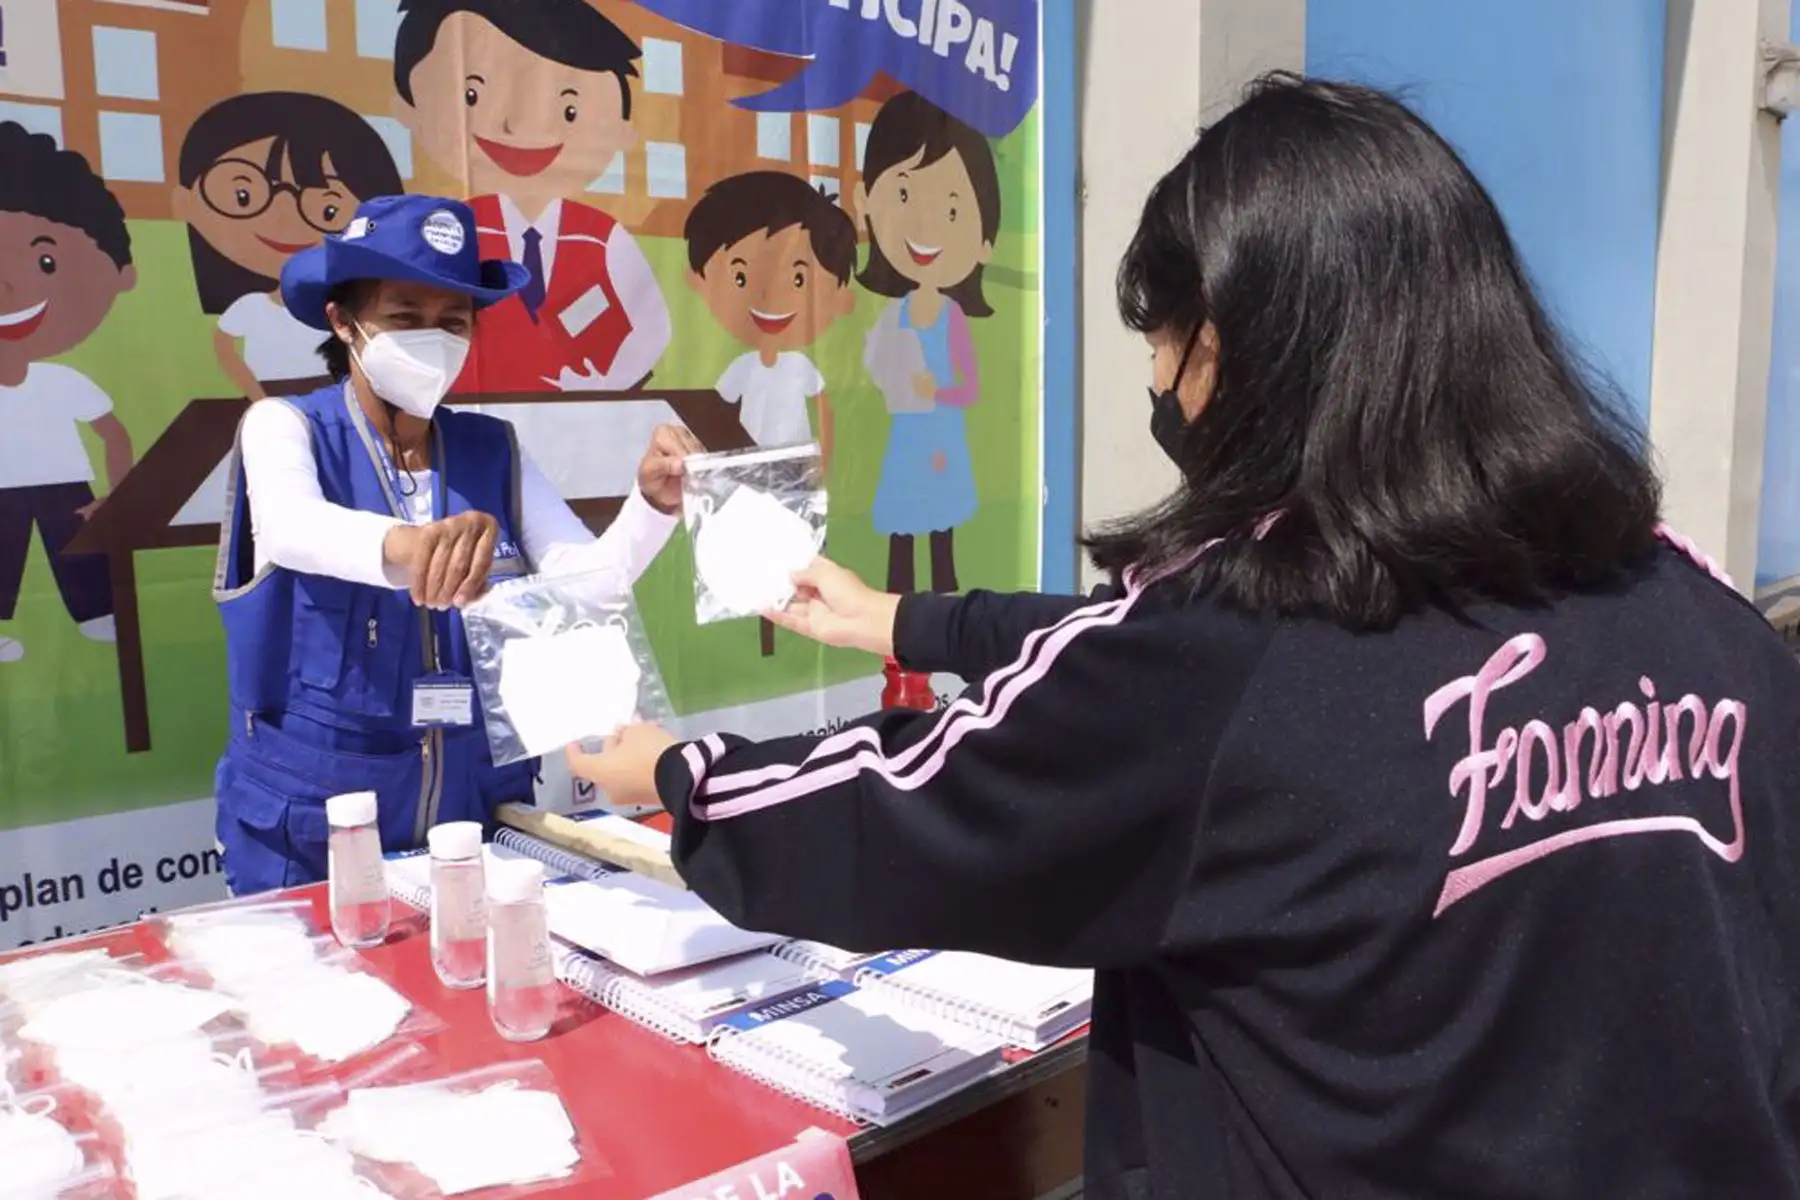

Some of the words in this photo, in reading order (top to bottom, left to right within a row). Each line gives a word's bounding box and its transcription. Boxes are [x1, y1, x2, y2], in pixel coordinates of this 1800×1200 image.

[1424, 632, 1746, 863] Fanning
[0, 873, 84, 922] plan
[98, 858, 143, 894] de
[748, 991, 827, 1022] MINSA
[747, 1160, 806, 1200] LA
